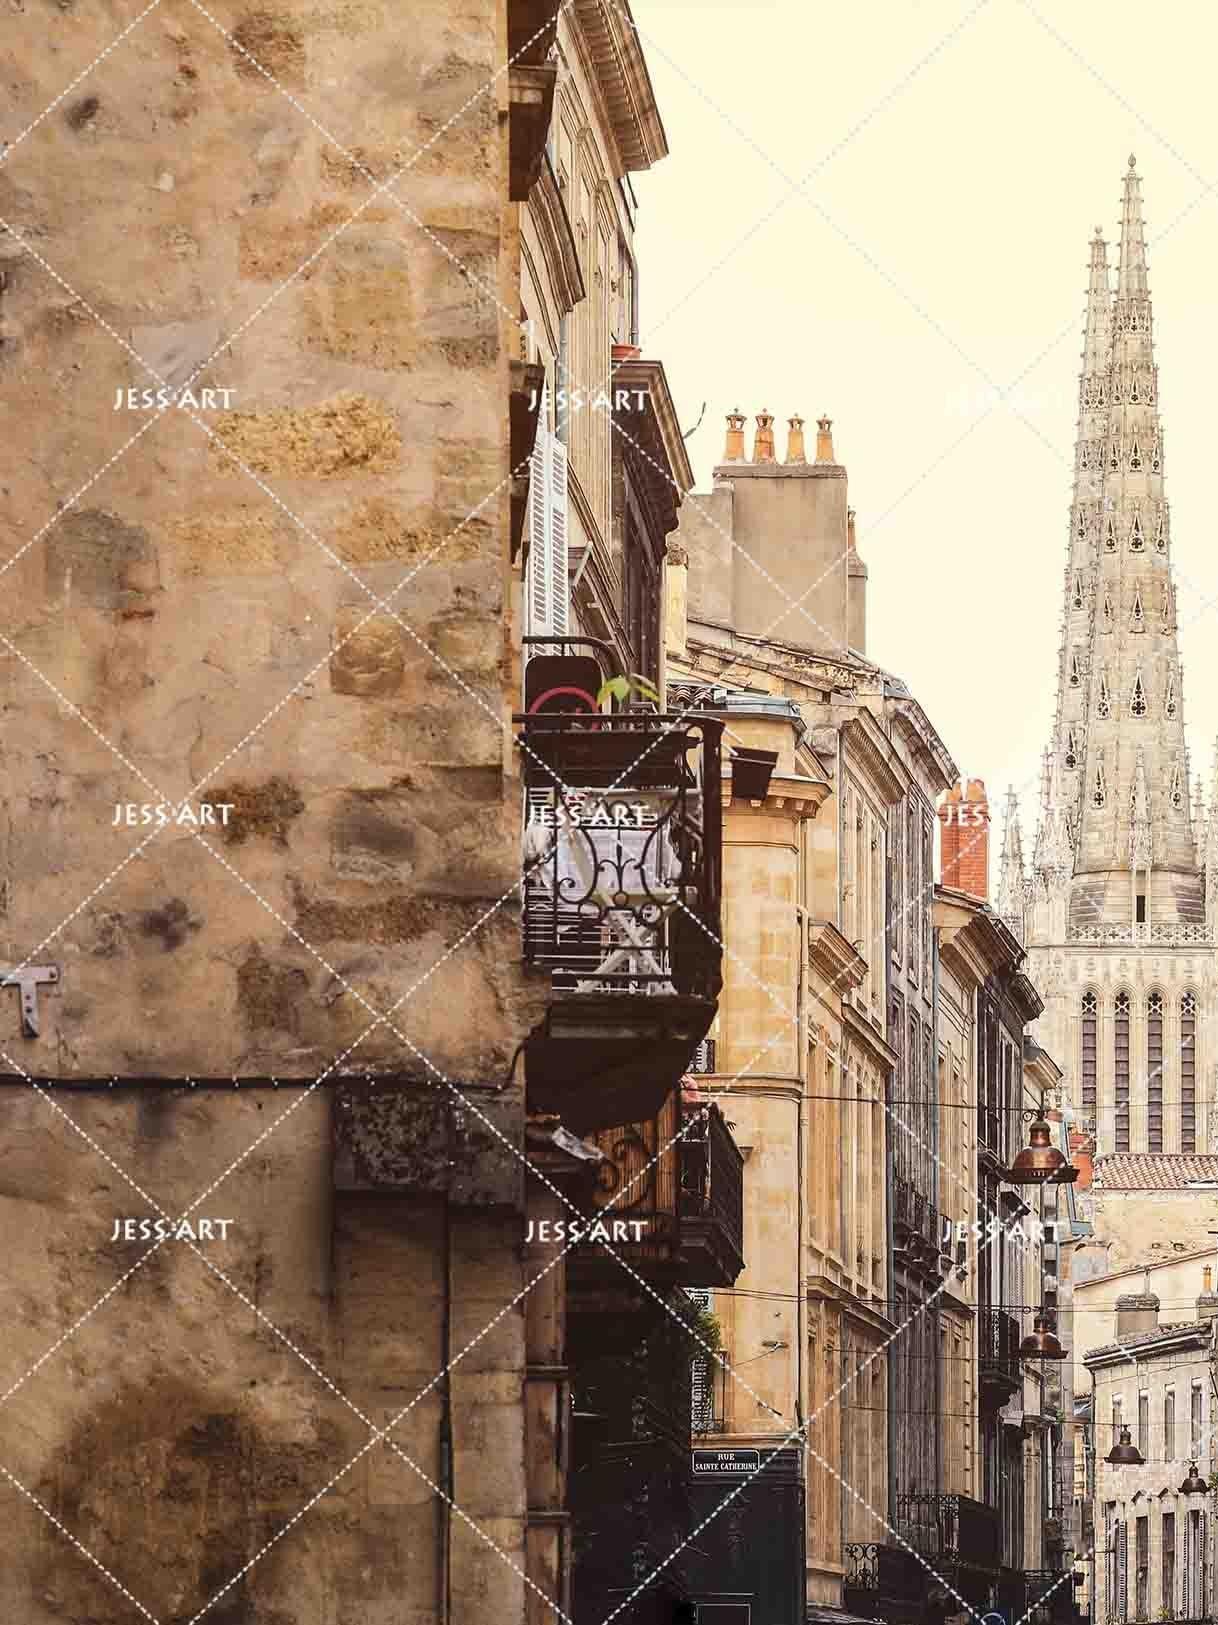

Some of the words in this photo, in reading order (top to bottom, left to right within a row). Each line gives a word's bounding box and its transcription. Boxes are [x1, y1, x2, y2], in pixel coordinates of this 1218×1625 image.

[718, 1453, 735, 1461] RUE
[695, 1463, 719, 1471] SAINTE
[720, 1463, 757, 1471] CATHERINE
